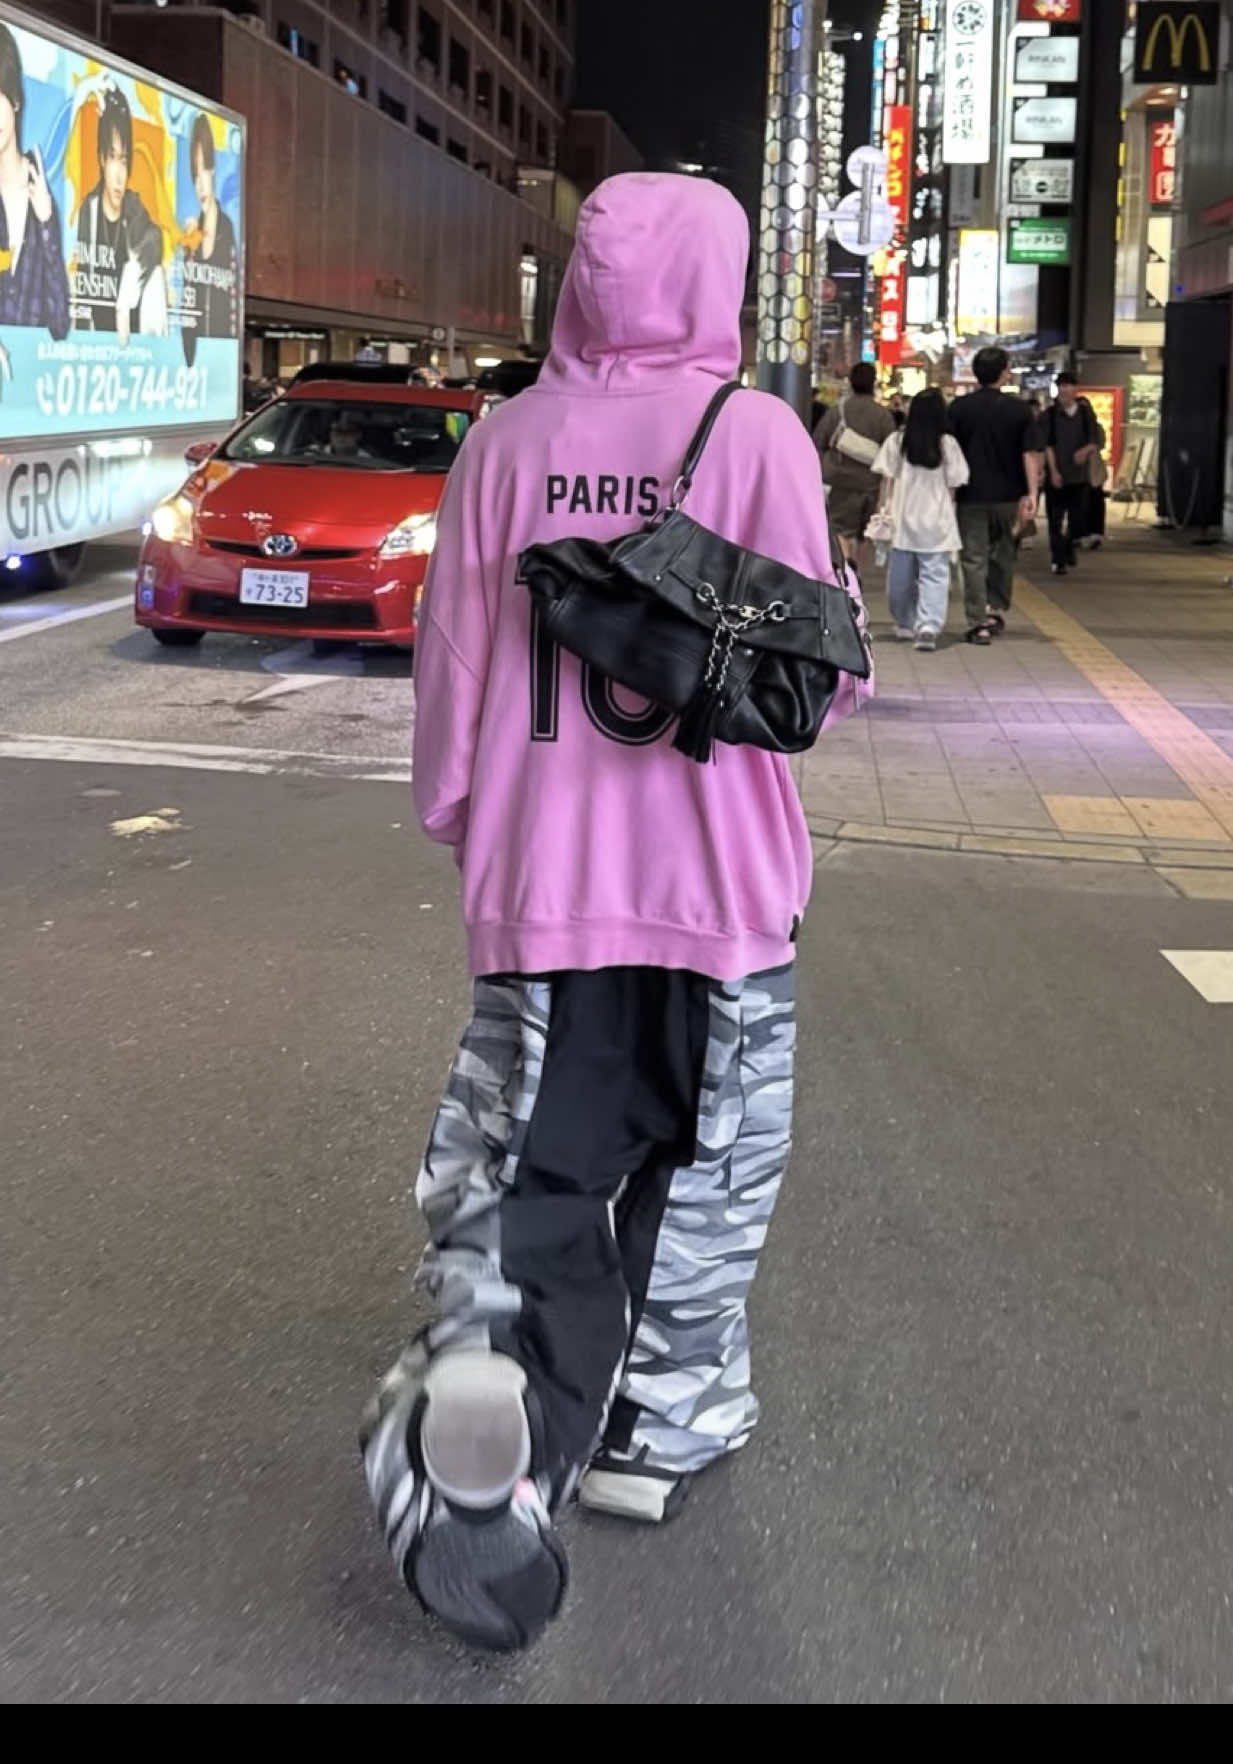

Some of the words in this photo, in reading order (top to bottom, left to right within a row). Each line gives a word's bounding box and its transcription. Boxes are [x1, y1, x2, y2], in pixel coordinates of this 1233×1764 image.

[56, 364, 207, 416] 0120-744-921
[547, 474, 660, 517] PARIS
[256, 583, 304, 604] 73-25
